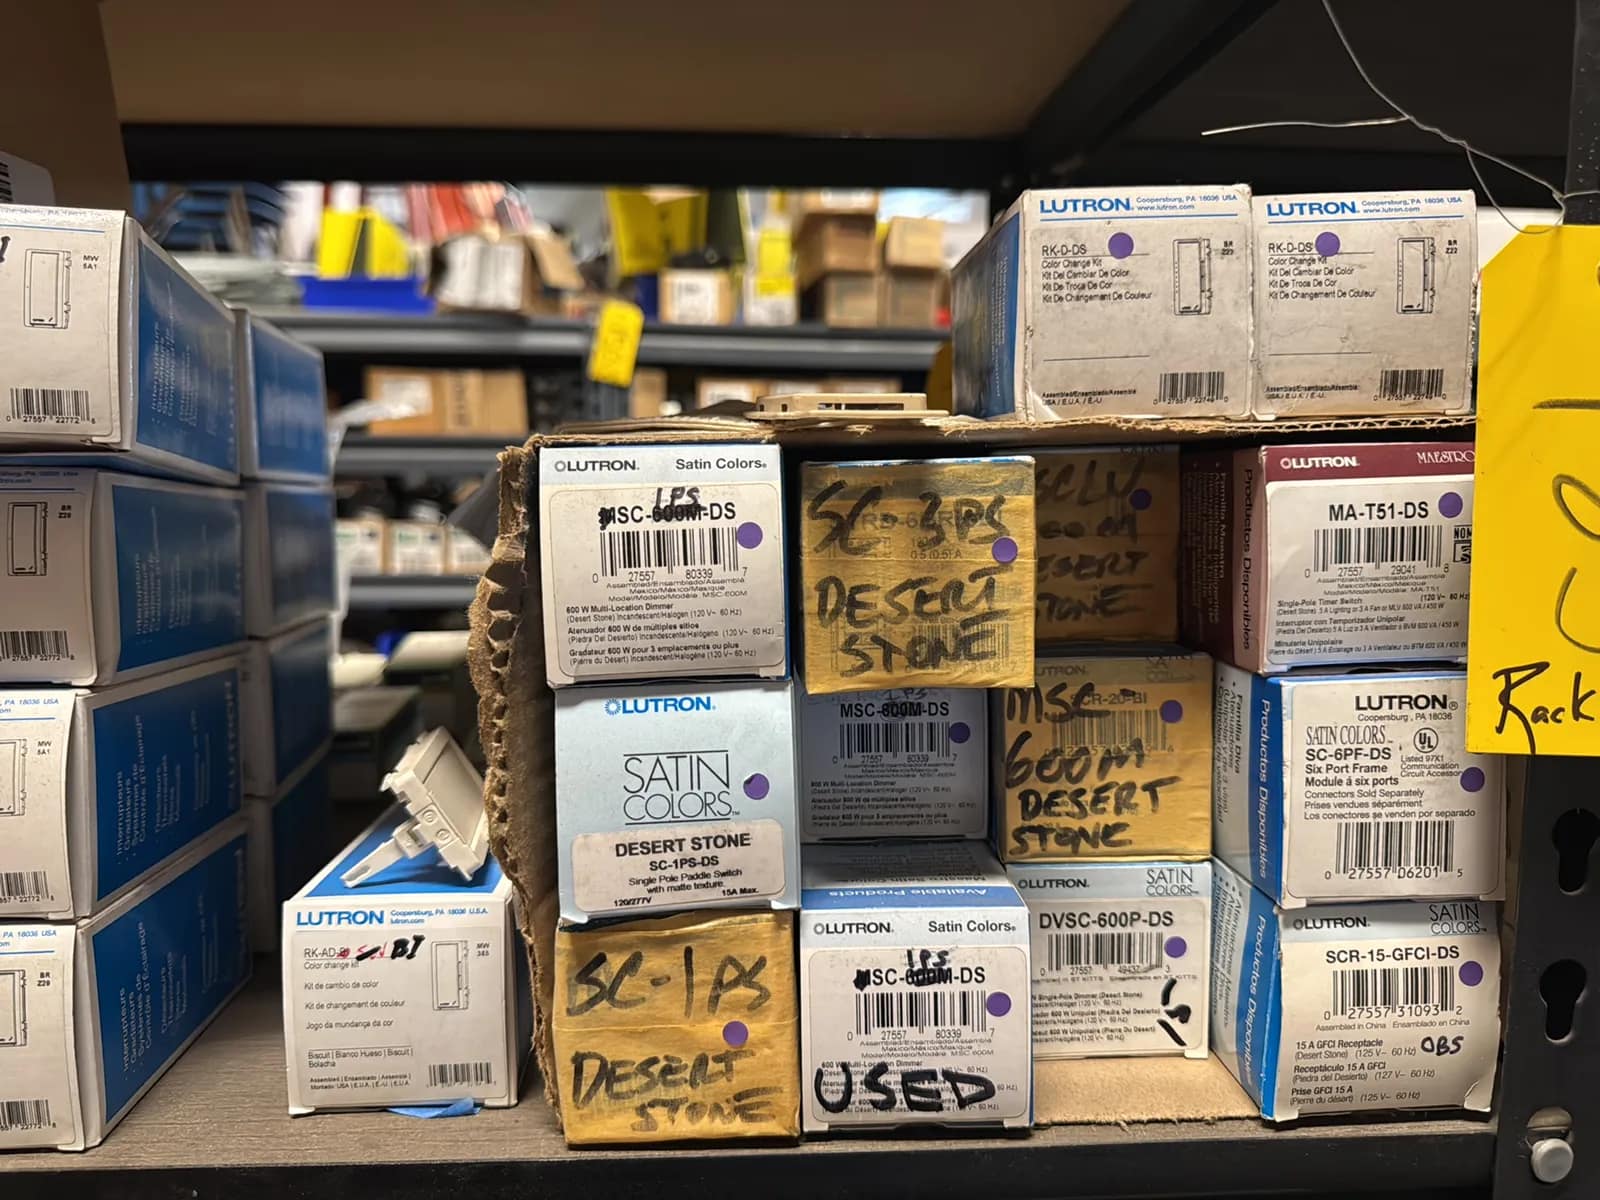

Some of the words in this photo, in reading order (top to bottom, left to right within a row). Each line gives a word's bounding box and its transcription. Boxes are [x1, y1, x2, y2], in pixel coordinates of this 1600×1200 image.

[1040, 198, 1130, 214] LUTRON
[1137, 203, 1195, 211] www.lutron.com
[1267, 201, 1356, 216] LUTRON
[1041, 245, 1087, 256] RK-D-DS
[1269, 242, 1312, 252] RK-D-DS
[1041, 260, 1060, 268] Color
[1063, 259, 1090, 269] Change
[567, 460, 636, 472] LUTRON
[676, 459, 712, 470] Satin
[716, 458, 762, 470] Colors
[1292, 457, 1357, 469] LUTRON
[1329, 502, 1429, 521] MA-T51-DS
[628, 571, 655, 582] 27557
[685, 568, 713, 579] 80339
[1338, 567, 1363, 577] 27557
[566, 606, 579, 614] 600
[581, 605, 589, 613] W
[591, 604, 643, 613] Multi-Location
[645, 602, 673, 611] Dimmer
[840, 609, 1009, 677] STONE
[1034, 665, 1086, 676] UTRON
[622, 696, 711, 714] LUTRON
[1492, 661, 1596, 756] Rack
[1306, 726, 1337, 745] SATIN
[1340, 725, 1386, 745] COLORS
[1305, 748, 1391, 761] SC-6PF-DS
[623, 753, 730, 794] SATIN
[1305, 764, 1322, 774] Six
[1326, 764, 1349, 773] Port
[1352, 764, 1388, 773] Frame
[1305, 777, 1343, 787] Module
[1355, 777, 1369, 785] six
[1372, 776, 1399, 787] ports
[1018, 776, 1182, 821] DESERT
[1357, 790, 1377, 798] Sold
[1379, 789, 1424, 799] Separately
[624, 791, 732, 821] COLORS
[1304, 812, 1319, 820] Los
[1322, 811, 1370, 819] conectores
[1419, 810, 1432, 818] por
[1435, 809, 1476, 818] separado
[1009, 822, 1132, 855] STONE
[615, 838, 686, 858] DESERT
[691, 833, 751, 851] STONE
[649, 856, 719, 871] SC-1PS-DS
[629, 877, 656, 886] Single
[659, 874, 678, 884] Pole
[680, 872, 711, 883] Paddle
[713, 868, 742, 879] Switch
[1146, 868, 1193, 884] SATIN
[1349, 867, 1390, 880] 27557
[647, 884, 664, 894] with
[667, 883, 691, 893] matte
[1029, 879, 1087, 888] LUTRON
[1146, 884, 1193, 895] COLORS
[722, 888, 738, 896] 15A
[296, 910, 384, 926] LUTRON
[1429, 904, 1479, 922] SATIN
[928, 921, 963, 932] Satin
[967, 920, 1011, 932] Colors
[1039, 911, 1174, 929] DVSC-600P-DS
[1303, 917, 1367, 929] LUTRON
[825, 923, 891, 934] LUTRON
[1431, 920, 1480, 934] COLORS
[1326, 946, 1459, 964] SCR-15-GFCI-DS
[304, 961, 323, 969] Color
[324, 961, 350, 969] change
[362, 980, 379, 988] color
[1348, 1007, 1390, 1019] 27557
[1397, 1004, 1440, 1016] 31093
[1316, 1023, 1356, 1032] Assembled
[1392, 1020, 1436, 1028] Ensamblado
[1296, 1041, 1307, 1049] 15
[1317, 1040, 1336, 1048] GFCI
[1338, 1038, 1383, 1048] Receptacle
[1420, 1035, 1464, 1056] OBS
[571, 1050, 756, 1110] DESERT
[815, 1062, 996, 1113] USED
[631, 1086, 783, 1132] STONE
